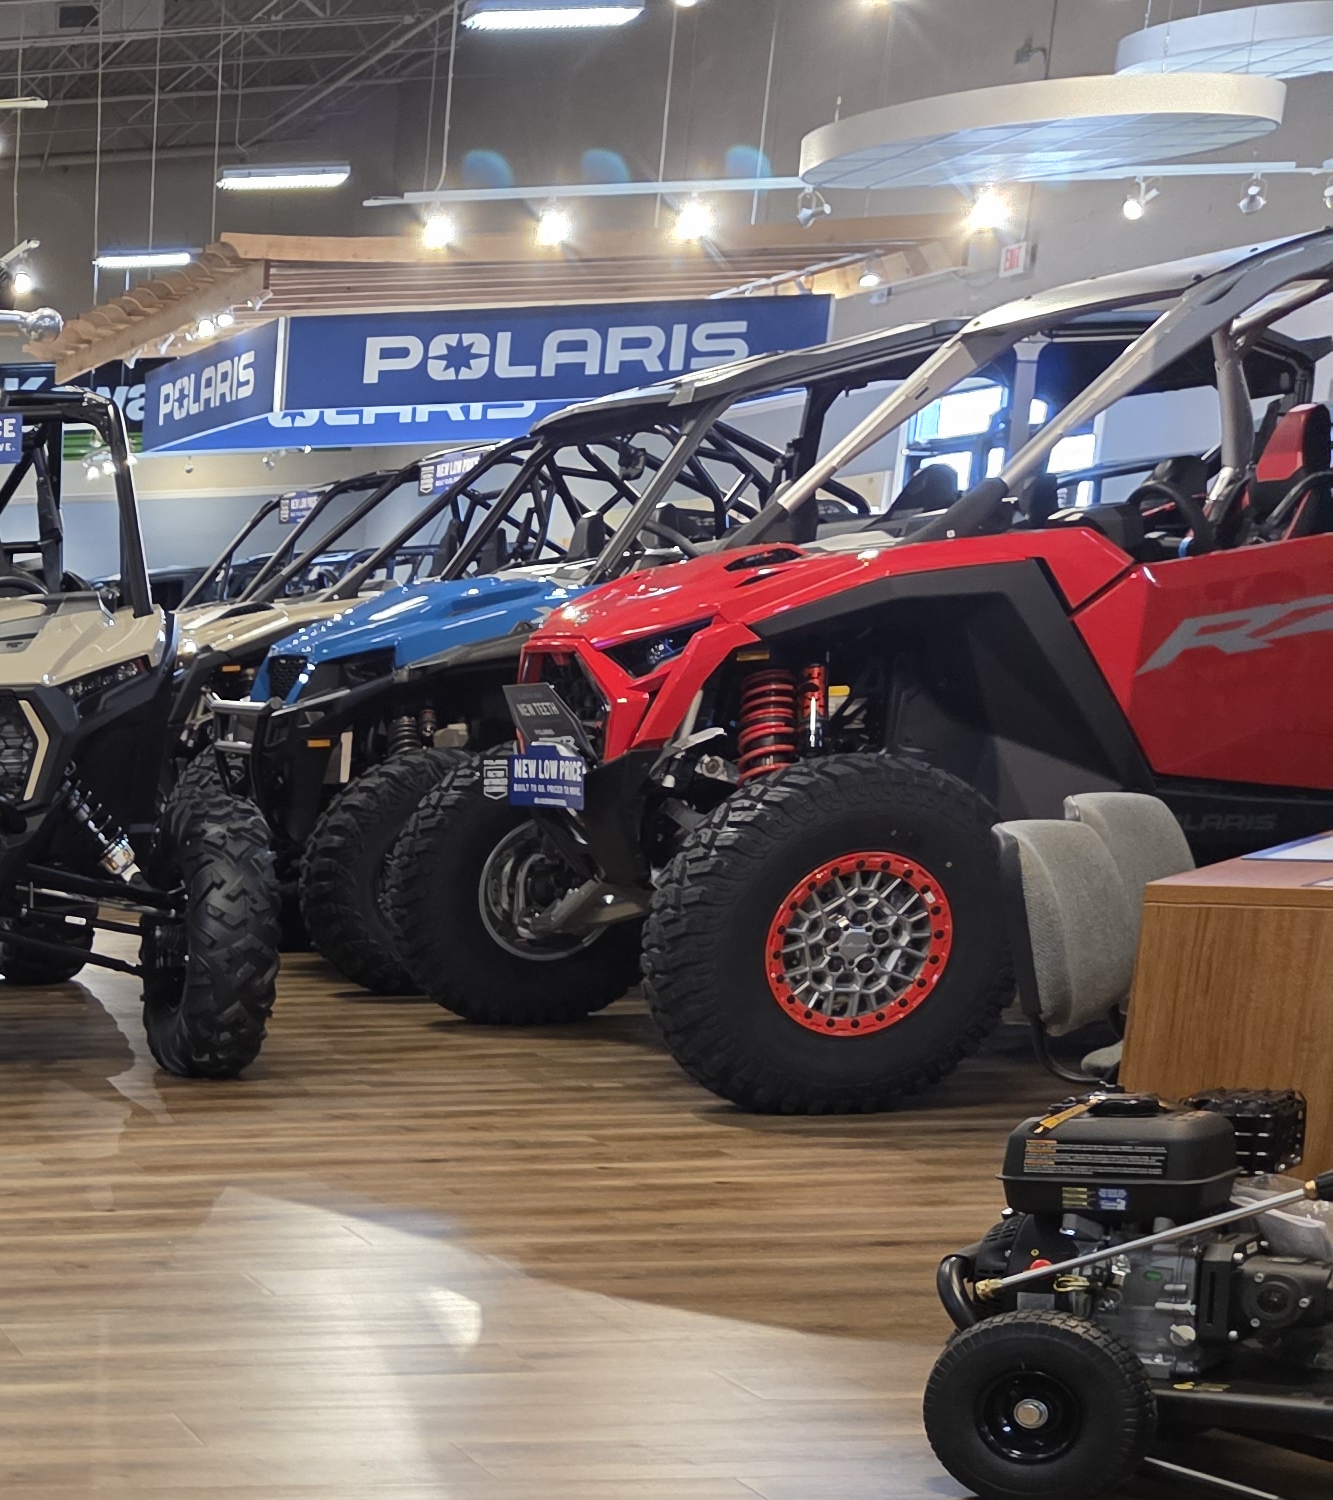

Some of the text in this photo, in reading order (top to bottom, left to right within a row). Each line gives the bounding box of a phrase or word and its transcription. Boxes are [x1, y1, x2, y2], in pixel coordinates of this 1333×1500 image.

[362, 320, 750, 384] POLARIS
[158, 350, 256, 426] POLARIS
[514, 758, 537, 779] NEW
[538, 759, 558, 779] LOW
[559, 760, 582, 782] PRICE
